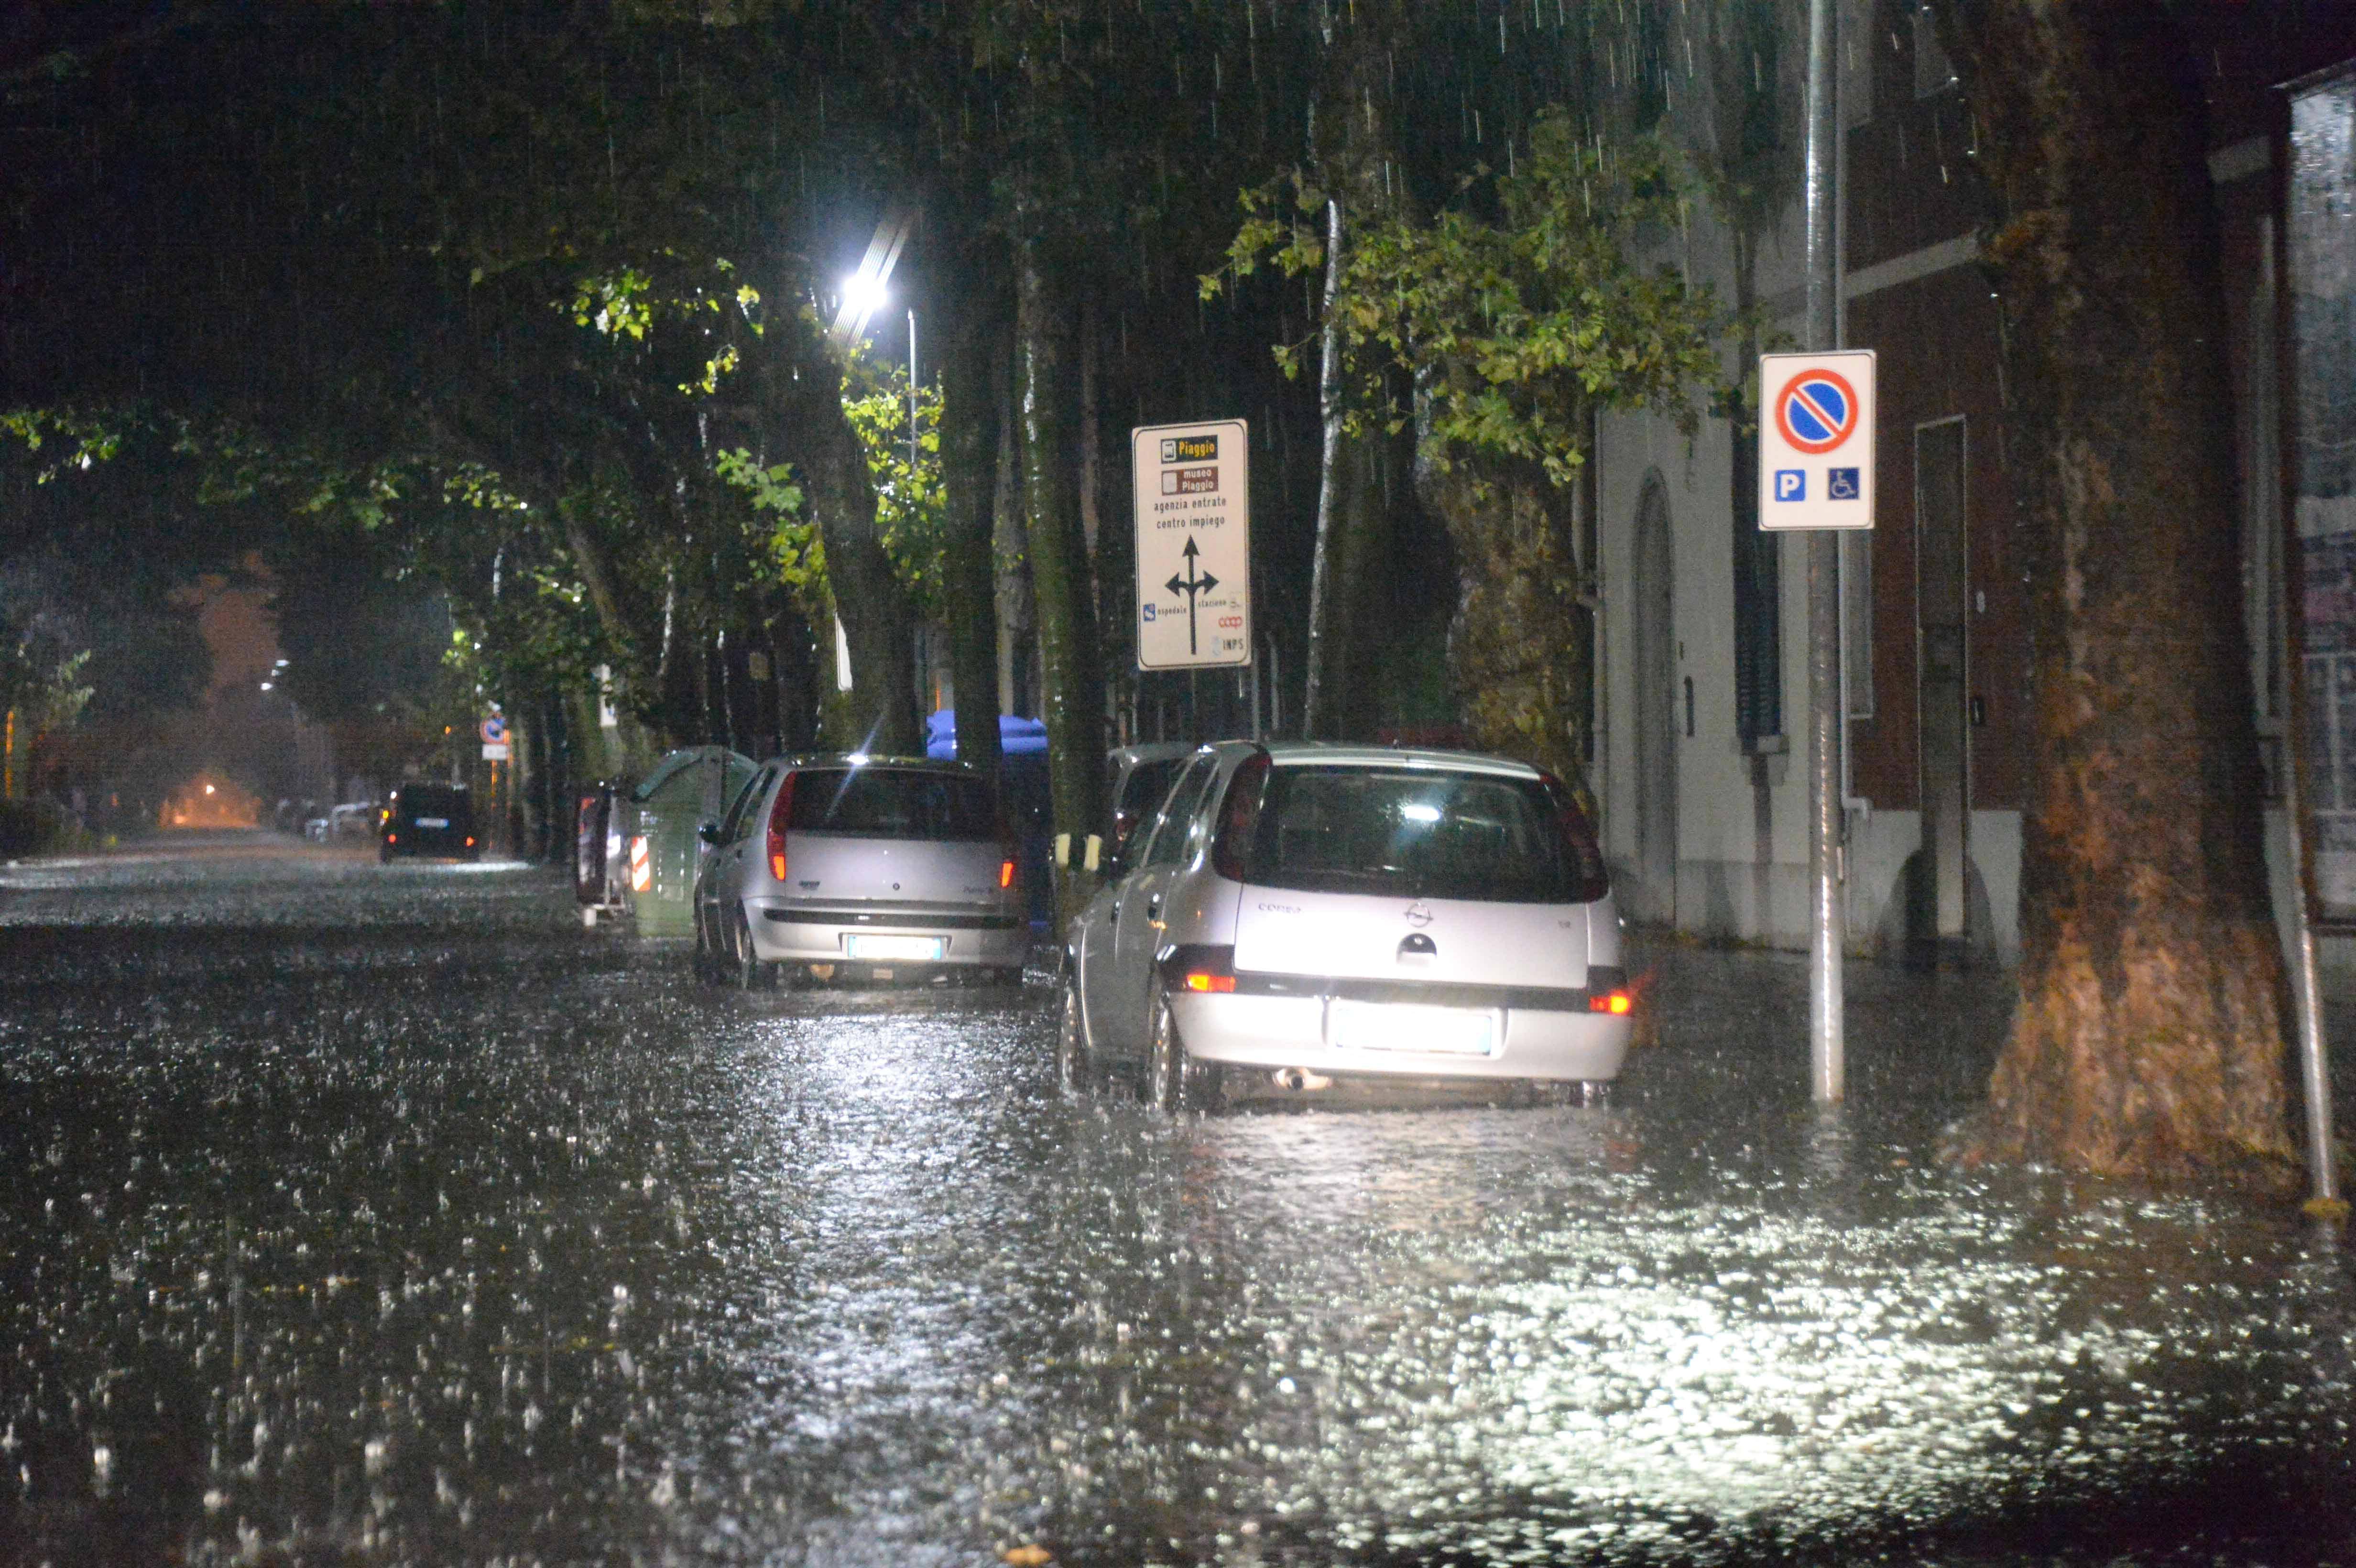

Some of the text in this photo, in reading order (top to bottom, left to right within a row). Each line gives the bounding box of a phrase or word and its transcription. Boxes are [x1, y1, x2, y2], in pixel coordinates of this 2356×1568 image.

[1179, 440, 1215, 457] Piaggio
[1184, 469, 1212, 479] museo
[1182, 479, 1214, 491] Piaggio
[1780, 474, 1800, 498] P
[1154, 495, 1226, 513] agenzia entrate
[1156, 514, 1225, 529] centro impiego
[1157, 605, 1187, 617] ospedale
[1222, 638, 1243, 651] INPS
